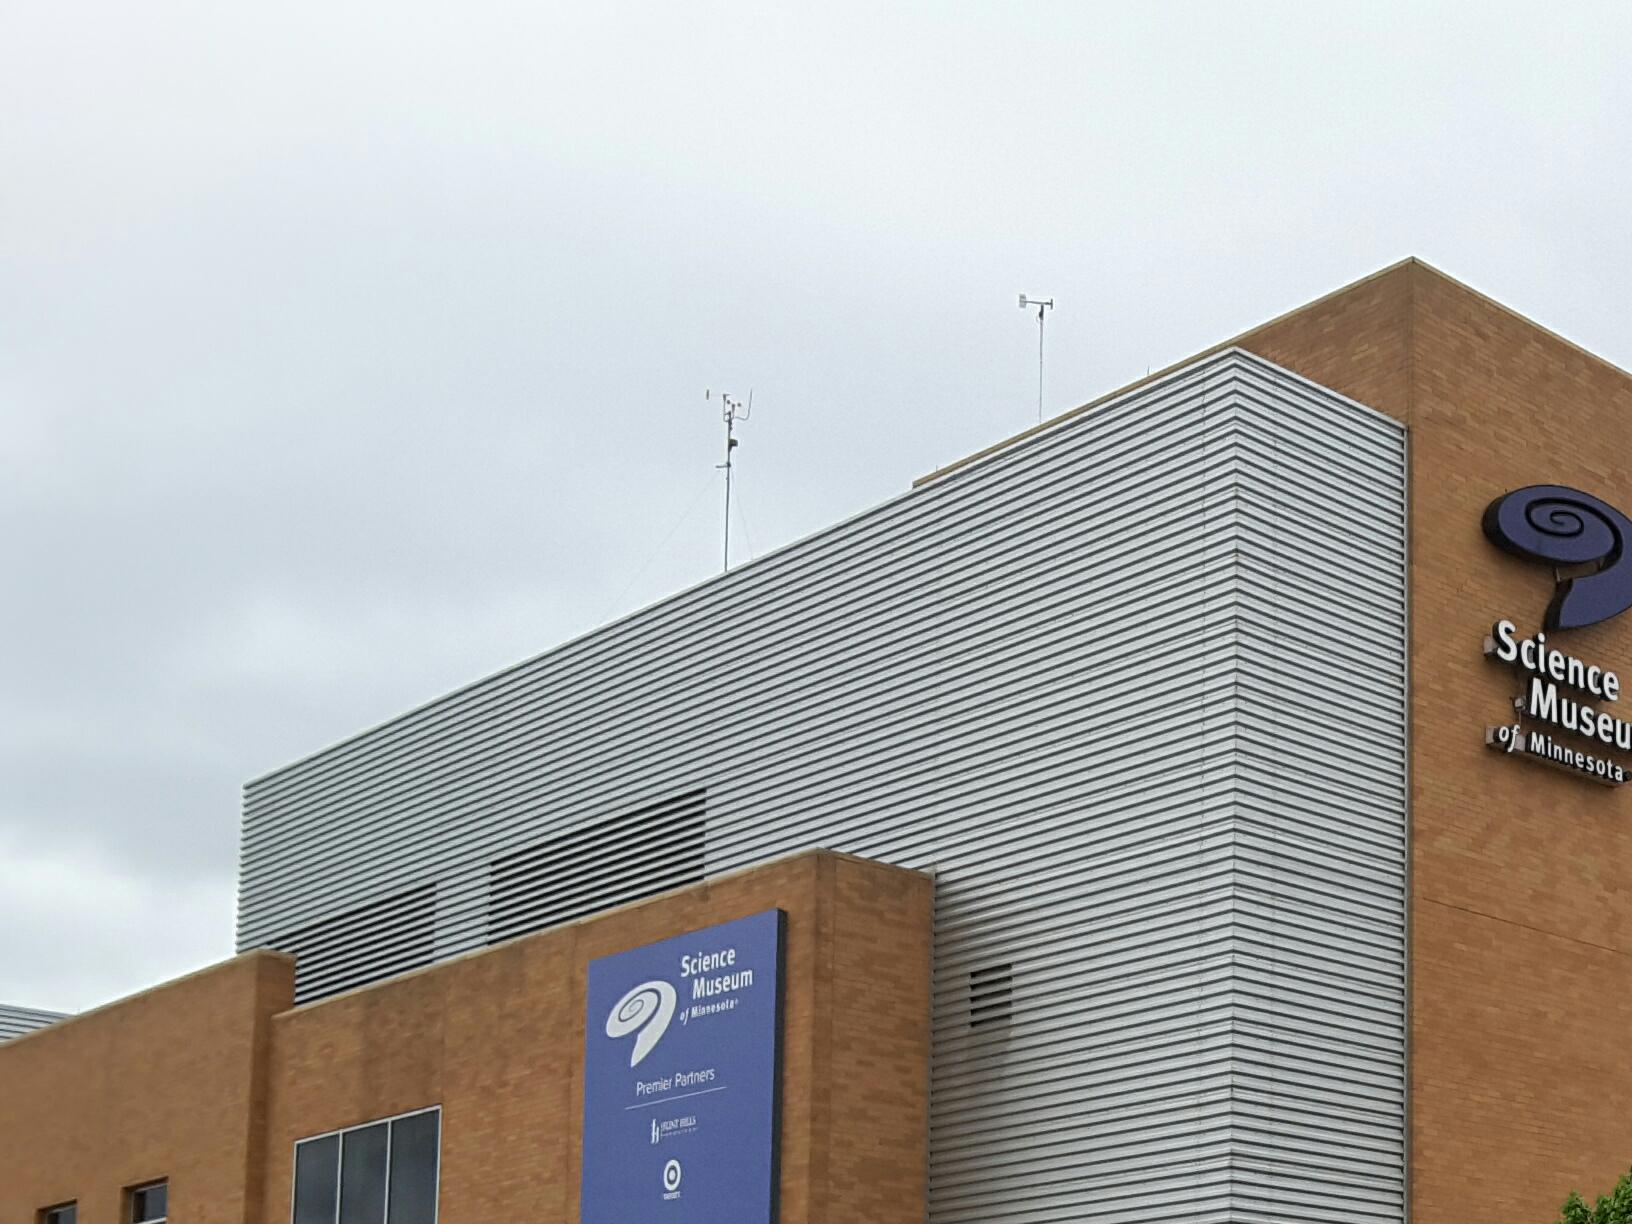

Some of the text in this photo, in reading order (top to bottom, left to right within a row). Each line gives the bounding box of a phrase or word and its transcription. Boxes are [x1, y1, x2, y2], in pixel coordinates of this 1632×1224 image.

[1497, 620, 1619, 701] Science
[1499, 724, 1623, 782] of Minnesota
[680, 948, 736, 977] Science
[692, 969, 753, 999] Museum
[680, 1008, 689, 1025] of
[636, 1068, 716, 1096] Premier Partners
